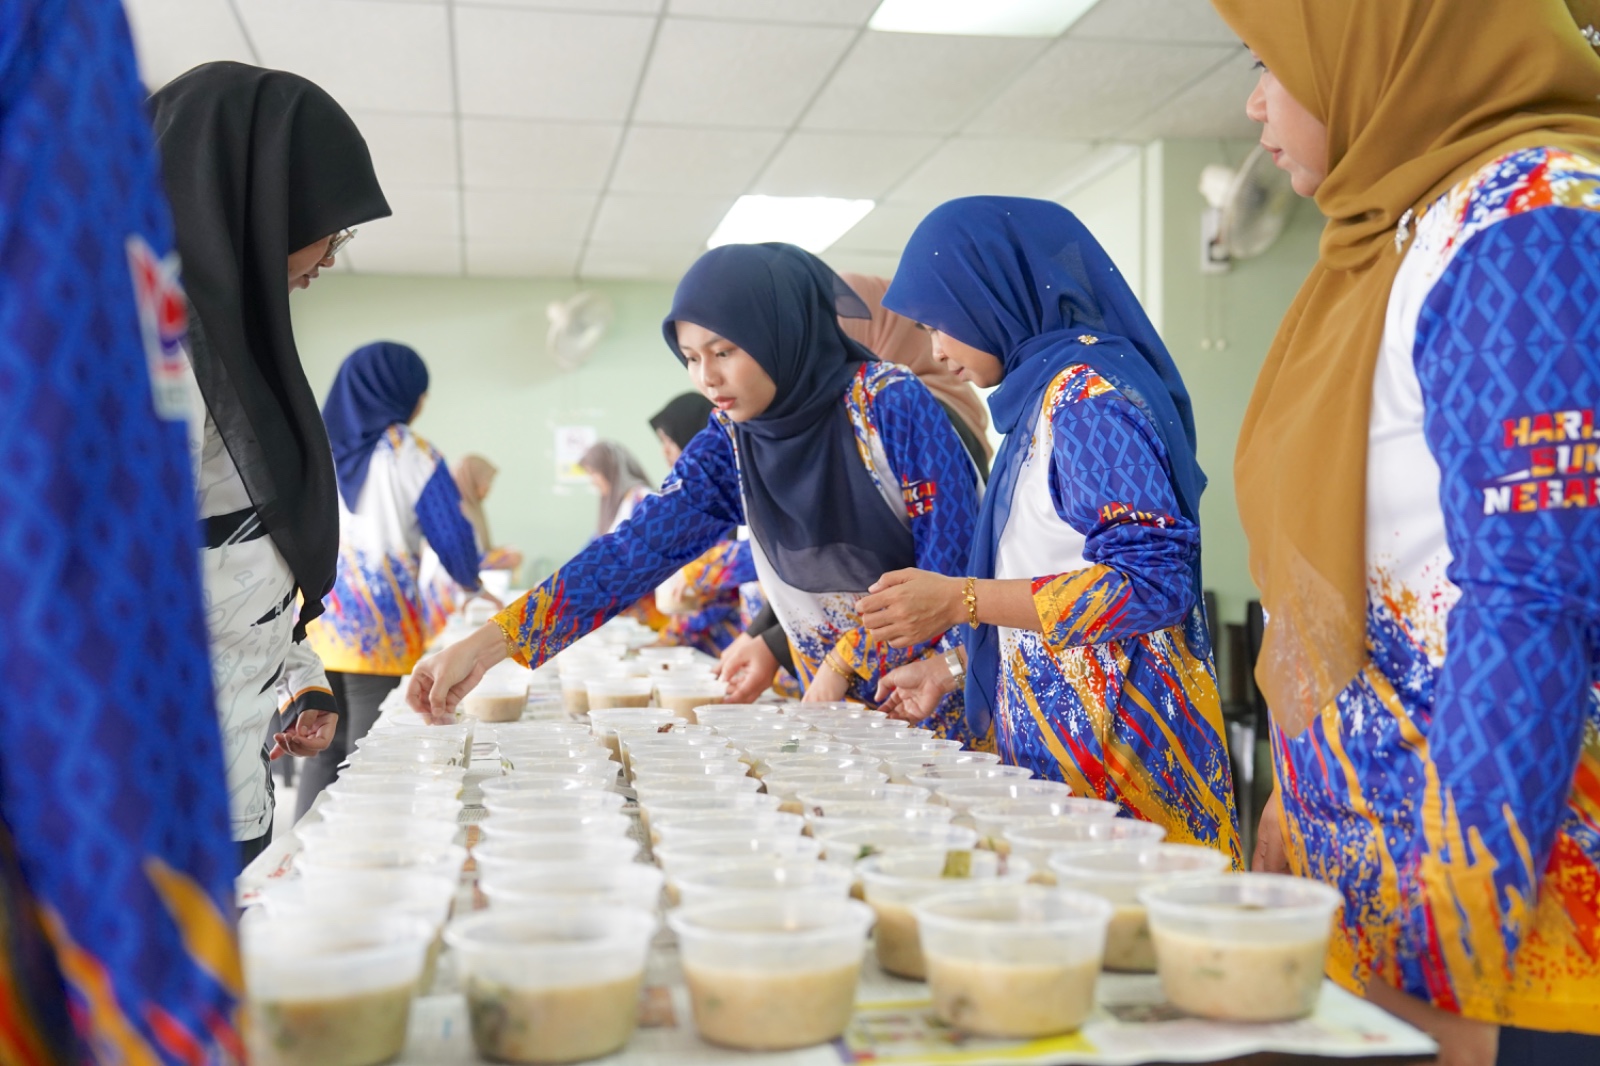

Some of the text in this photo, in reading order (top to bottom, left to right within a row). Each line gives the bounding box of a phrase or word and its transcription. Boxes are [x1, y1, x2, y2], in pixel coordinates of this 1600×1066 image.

[1503, 409, 1594, 449] HARI
[1530, 443, 1600, 478] SUK
[1483, 477, 1600, 516] NEGA
